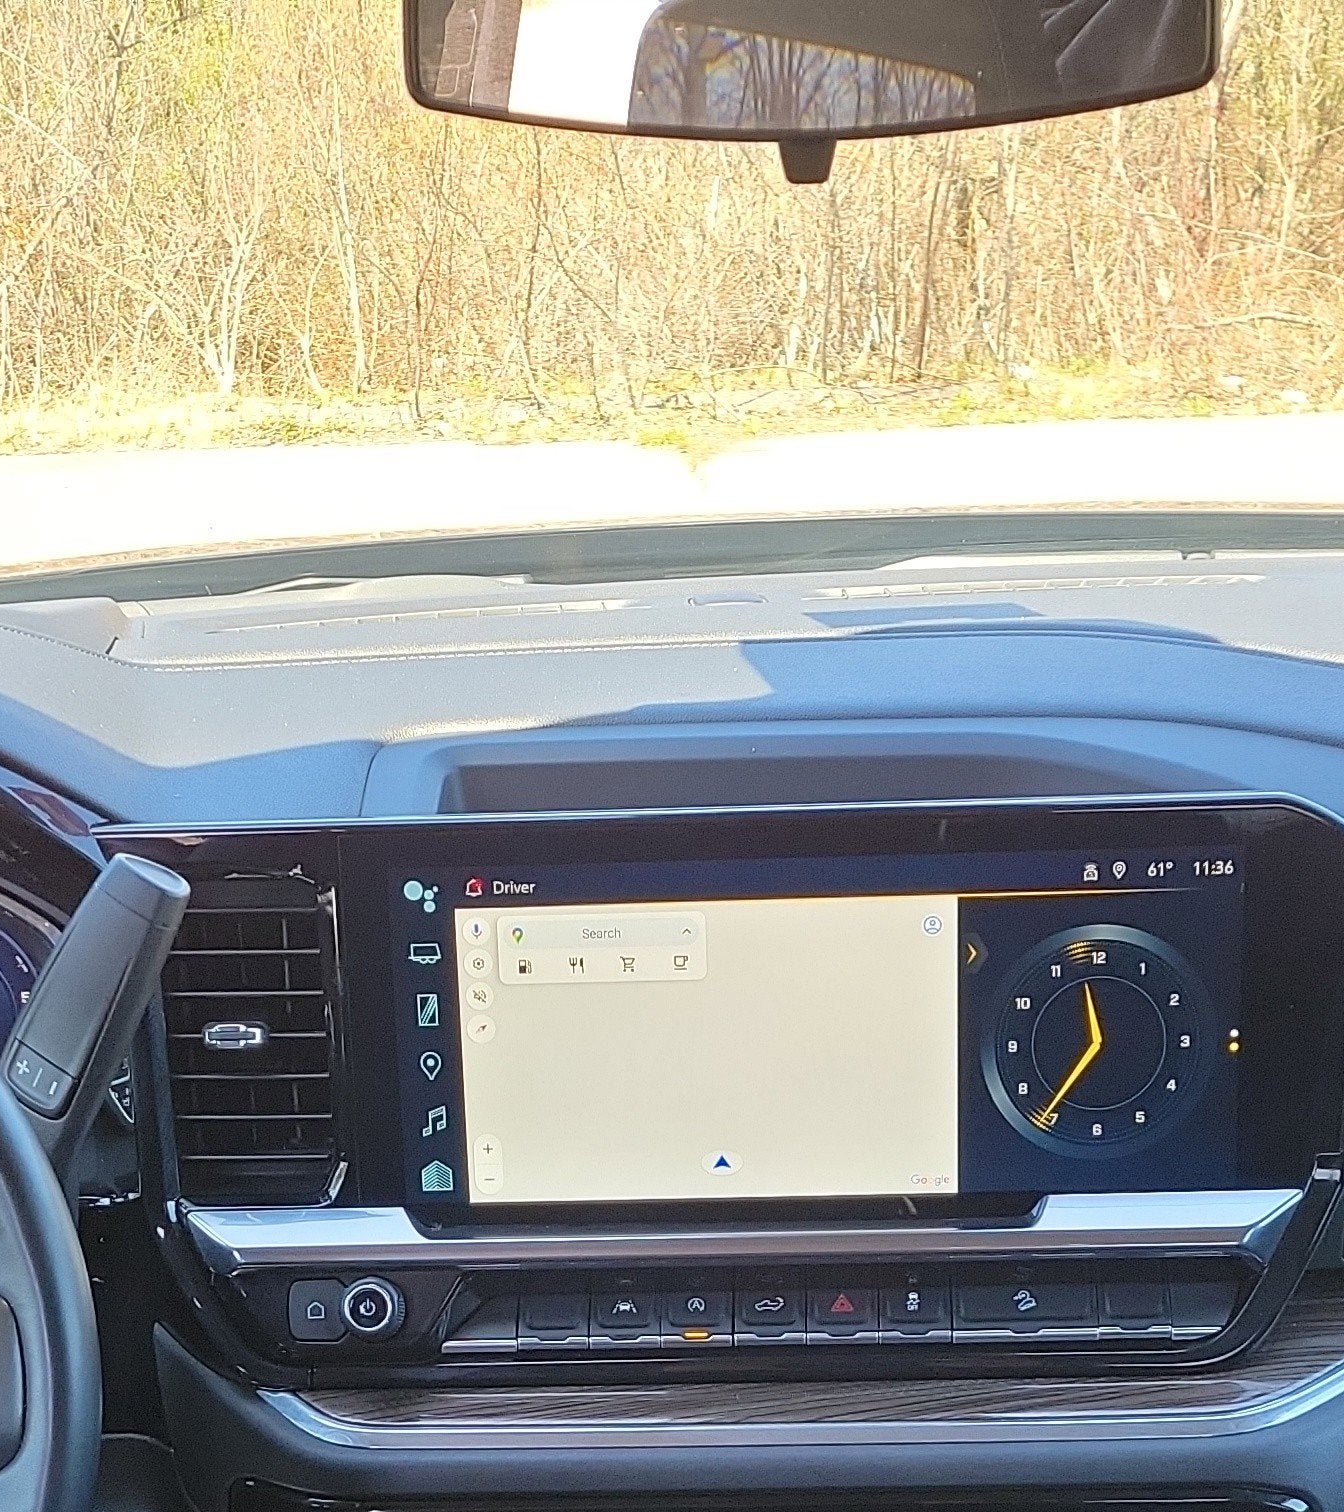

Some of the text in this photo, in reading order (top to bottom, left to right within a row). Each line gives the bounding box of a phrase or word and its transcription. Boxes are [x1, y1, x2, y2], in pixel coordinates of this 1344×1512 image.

[1147, 860, 1234, 877] 61° 11:36
[493, 880, 536, 895] Driver
[582, 928, 621, 940] Search
[1091, 951, 1107, 965] 12
[1050, 965, 1062, 978] 11
[1139, 963, 1146, 975] 1
[1015, 997, 1031, 1010] 10
[1169, 994, 1180, 1006] 2
[1007, 1040, 1018, 1053] 9
[1179, 1035, 1191, 1048] 3
[1017, 1083, 1029, 1095] 8
[1166, 1078, 1177, 1092] 4
[1134, 1111, 1146, 1124] 5
[1092, 1123, 1103, 1136] 6
[910, 1173, 950, 1187] Google
